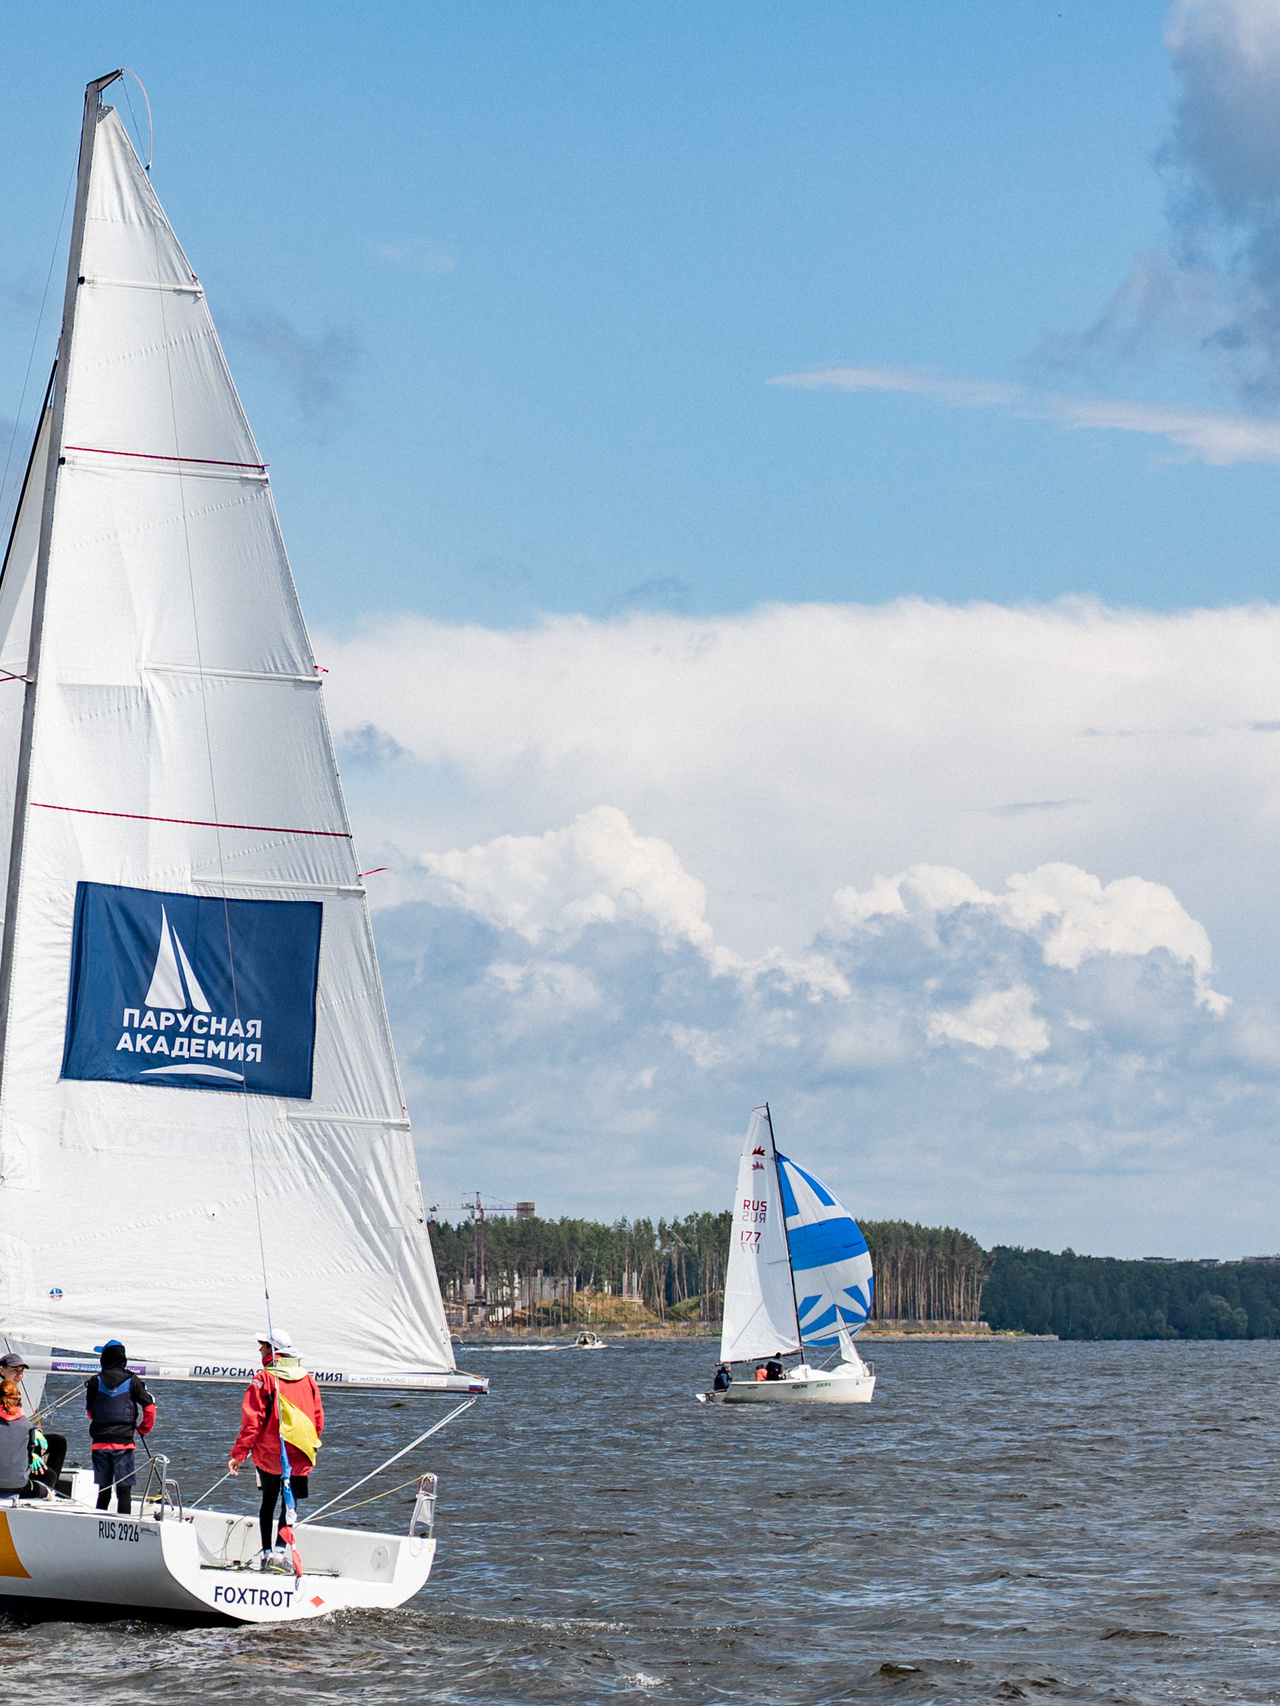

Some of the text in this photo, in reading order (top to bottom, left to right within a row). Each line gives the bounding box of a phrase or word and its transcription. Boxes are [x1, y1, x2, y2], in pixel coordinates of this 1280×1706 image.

[122, 1007, 262, 1039] ПАРУСНАЯ
[115, 1031, 263, 1063] АКАДЕМИЯ
[742, 1199, 767, 1212] RUS
[740, 1230, 761, 1243] 177
[98, 1520, 140, 1542] RUS 2926
[214, 1585, 294, 1608] FOXTROT
